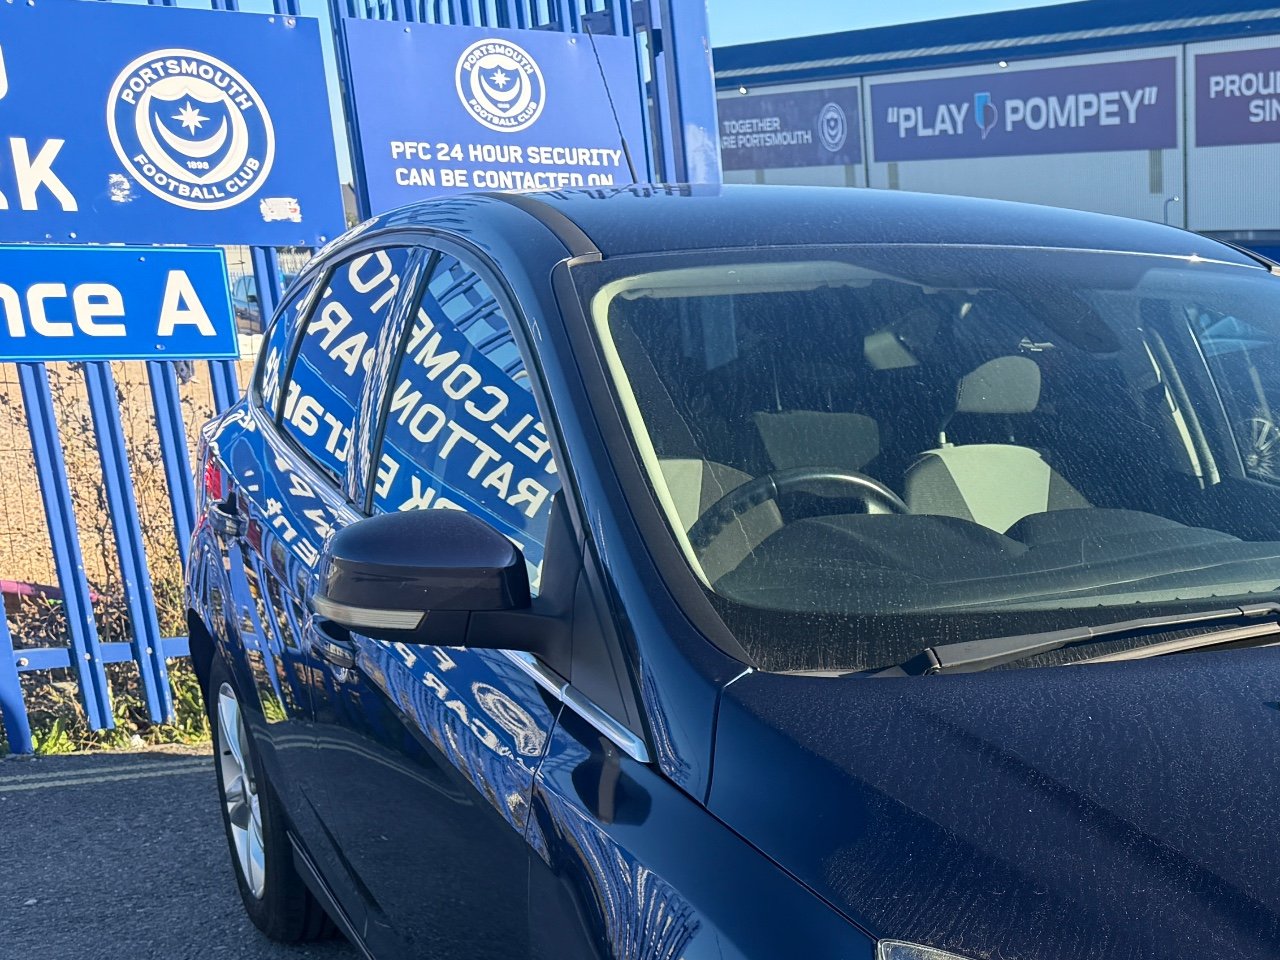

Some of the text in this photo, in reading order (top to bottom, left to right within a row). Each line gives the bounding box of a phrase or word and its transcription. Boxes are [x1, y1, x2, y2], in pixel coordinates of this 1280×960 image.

[463, 44, 534, 74] PORTSMOUTH
[121, 59, 253, 111] PORTSMOUTH
[469, 99, 537, 125] FOOTBALL CLUB
[723, 117, 780, 134] TOGETHER
[738, 130, 812, 148] PORTSMOUTH
[186, 160, 210, 170] 1898
[390, 141, 622, 167] PFC 24 HOUR SECURITY
[133, 153, 261, 200] FOOTBALL CLUB
[395, 168, 614, 189] CAN BE CONTACTED ON
[157, 270, 217, 337] A
